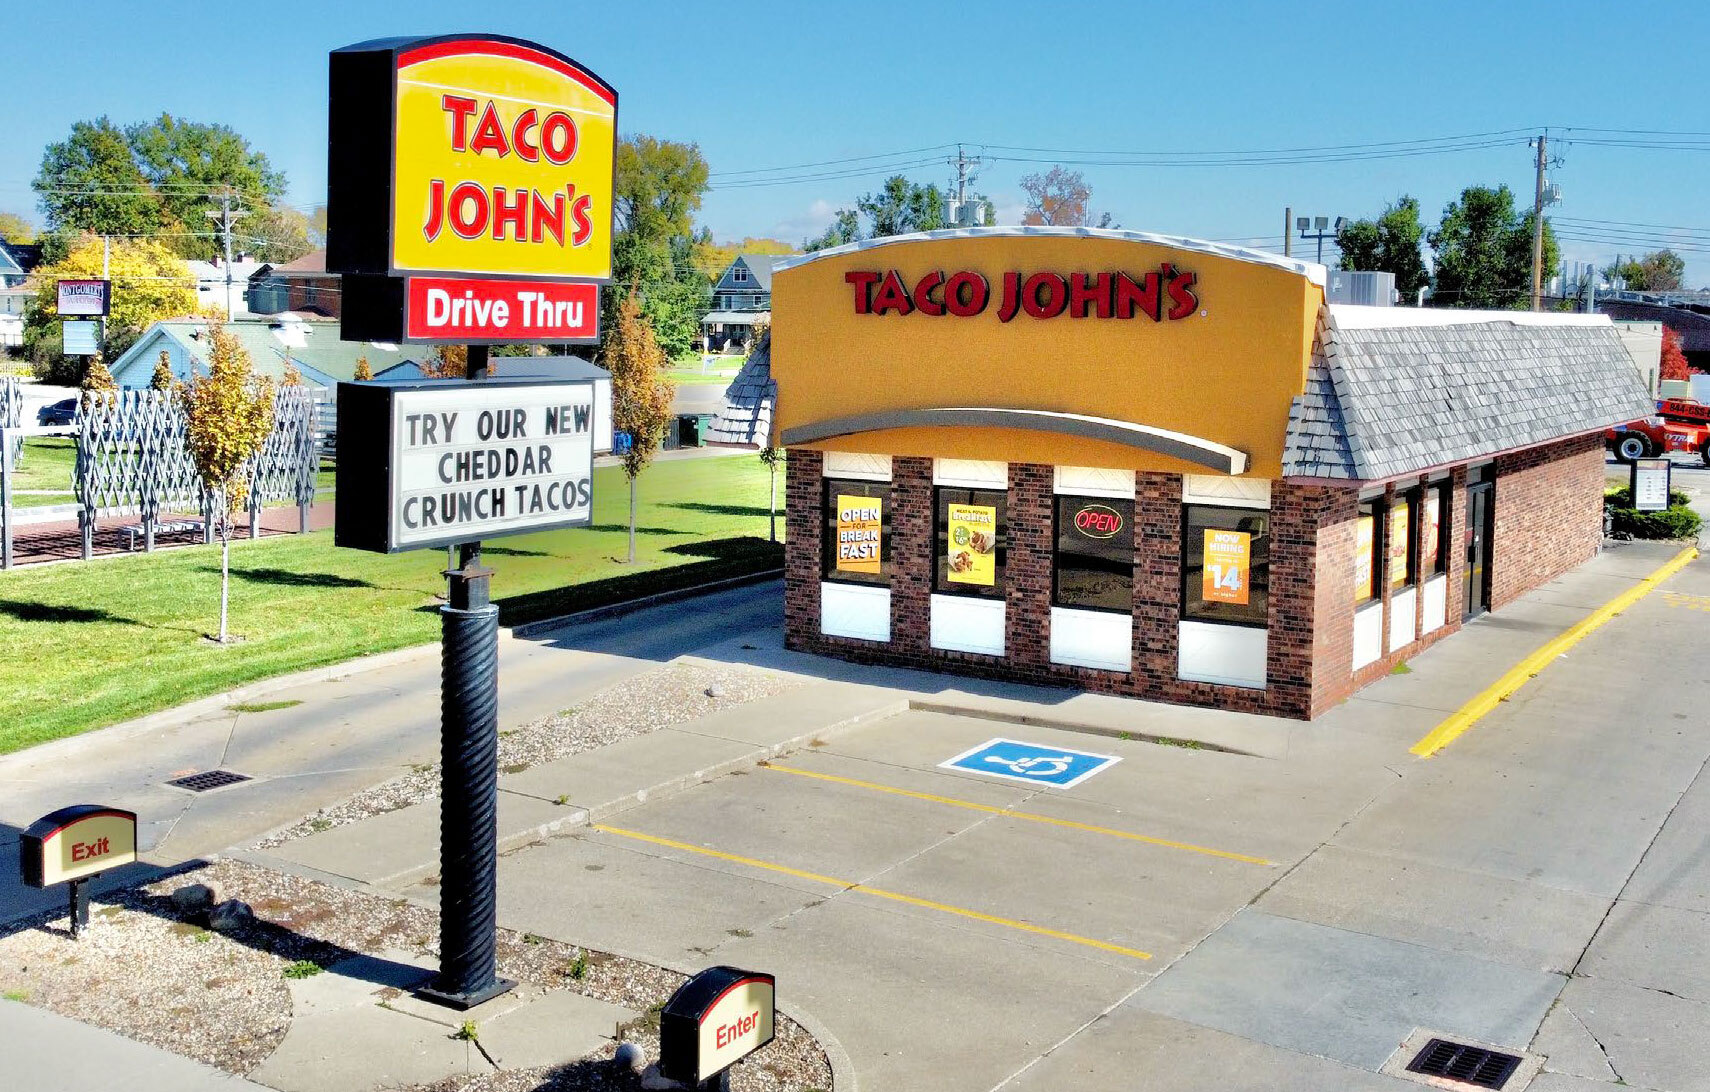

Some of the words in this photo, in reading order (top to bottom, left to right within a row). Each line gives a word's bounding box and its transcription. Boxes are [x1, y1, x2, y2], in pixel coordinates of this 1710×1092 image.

[442, 94, 578, 165] TACO
[423, 179, 593, 247] JOHN'S
[426, 288, 509, 327] Drive
[517, 291, 583, 328] Thru
[845, 269, 990, 317] TACO
[996, 262, 1199, 323] JOHN'S
[405, 412, 458, 446] TRY
[477, 408, 527, 441] OUR
[545, 404, 591, 435] NEW
[438, 444, 552, 484] CHEDDAR
[402, 488, 505, 529] CRUNCH
[514, 478, 590, 514] TACOS
[840, 508, 879, 522] OPEN
[1077, 511, 1119, 531] OPEN
[840, 530, 879, 543] BREAK
[840, 543, 878, 559] FAST
[1209, 543, 1244, 553] HIRING
[1214, 534, 1240, 543] NOW
[71, 836, 110, 862] Exit
[716, 1010, 759, 1050] Enter
